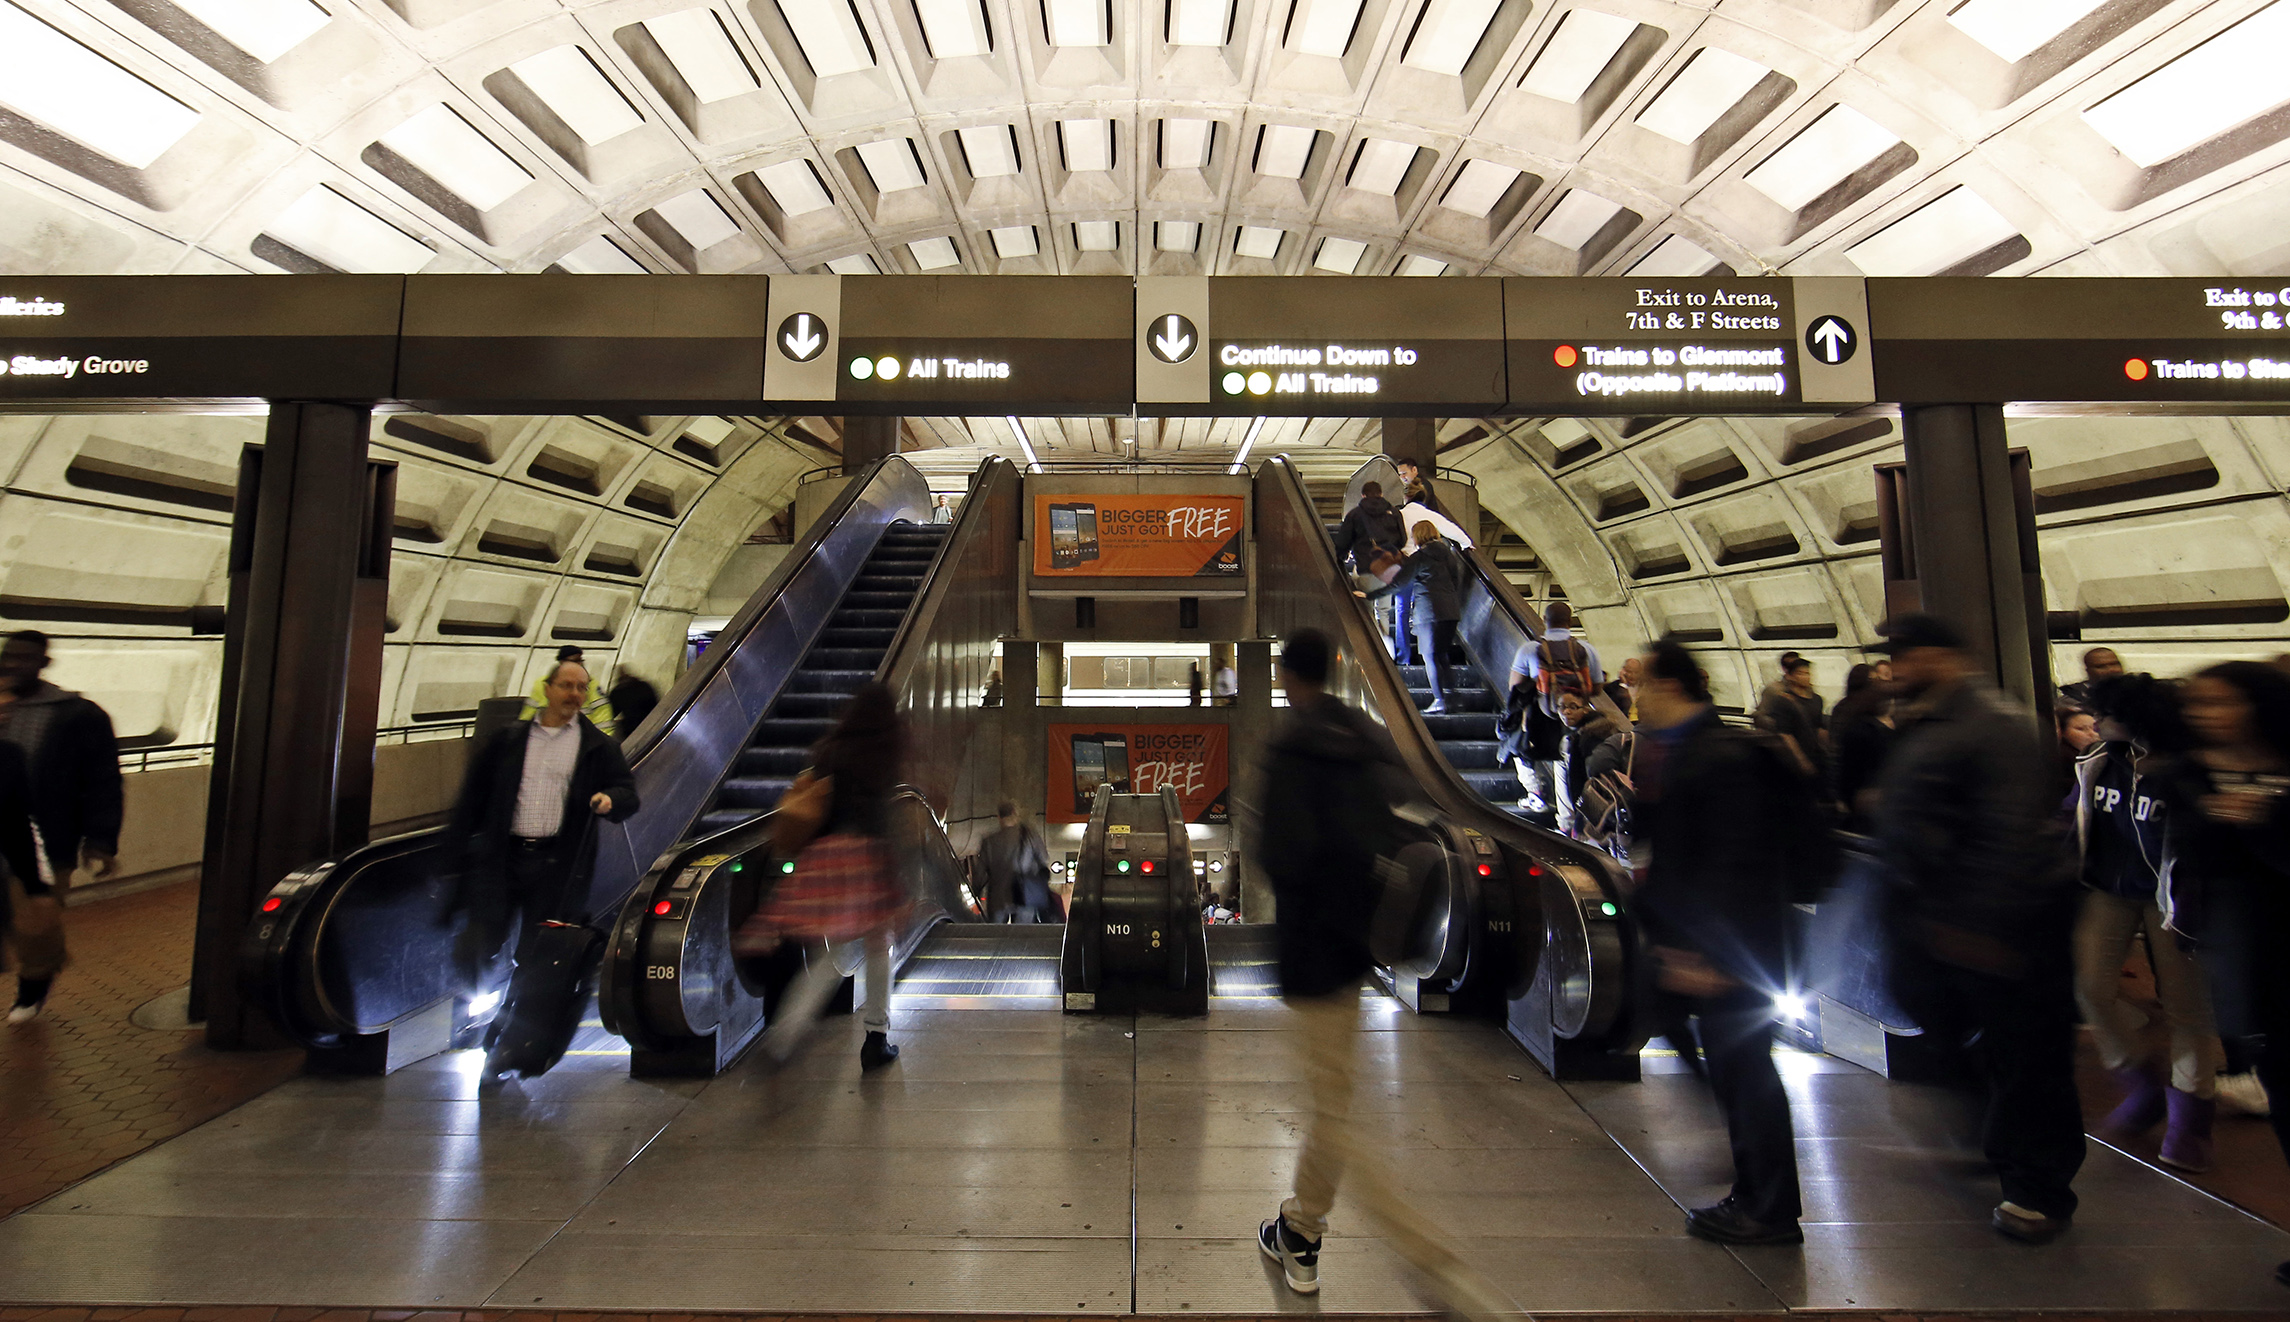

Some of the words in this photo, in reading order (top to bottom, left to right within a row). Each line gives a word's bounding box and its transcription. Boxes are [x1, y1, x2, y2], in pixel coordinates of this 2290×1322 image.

[1635, 288, 1682, 307] Exit
[1686, 291, 1708, 307] to
[1711, 288, 1779, 310] Arena,
[2204, 287, 2252, 307] Exit
[2253, 291, 2278, 307] to
[1625, 312, 1661, 330] 7th
[1665, 312, 1686, 330] &
[1690, 312, 1706, 330] F
[1711, 312, 1781, 330] Streets
[2221, 311, 2259, 330] 9th
[2260, 311, 2284, 330] &
[1221, 344, 1322, 366] Continue
[1326, 345, 1390, 366] Down
[1393, 347, 1418, 366] to
[1582, 346, 1649, 366] Trains
[1651, 347, 1676, 366] to
[1679, 346, 1785, 366] Glenmont
[10, 355, 80, 379] Shady
[83, 355, 149, 374] Grove
[907, 358, 938, 379] All
[942, 358, 1010, 379] Trains
[2151, 359, 2222, 379] Trains
[2221, 360, 2248, 379] to
[1274, 373, 1306, 393] All
[1309, 373, 1379, 393] Trains
[1576, 371, 1684, 396] (Opposite
[1686, 371, 1786, 396] Platform)
[1102, 509, 1168, 523] BIGGER
[1166, 506, 1231, 538] FREE
[1102, 525, 1135, 536] JUST
[1138, 525, 1168, 536] GOT
[1134, 734, 1206, 749] BIGGER
[1134, 752, 1171, 763] JUST
[1174, 751, 1206, 763] GOT
[1133, 761, 1205, 796] FREE
[1106, 924, 1131, 936] N10
[1488, 920, 1512, 933] N11
[646, 965, 675, 980] E08
